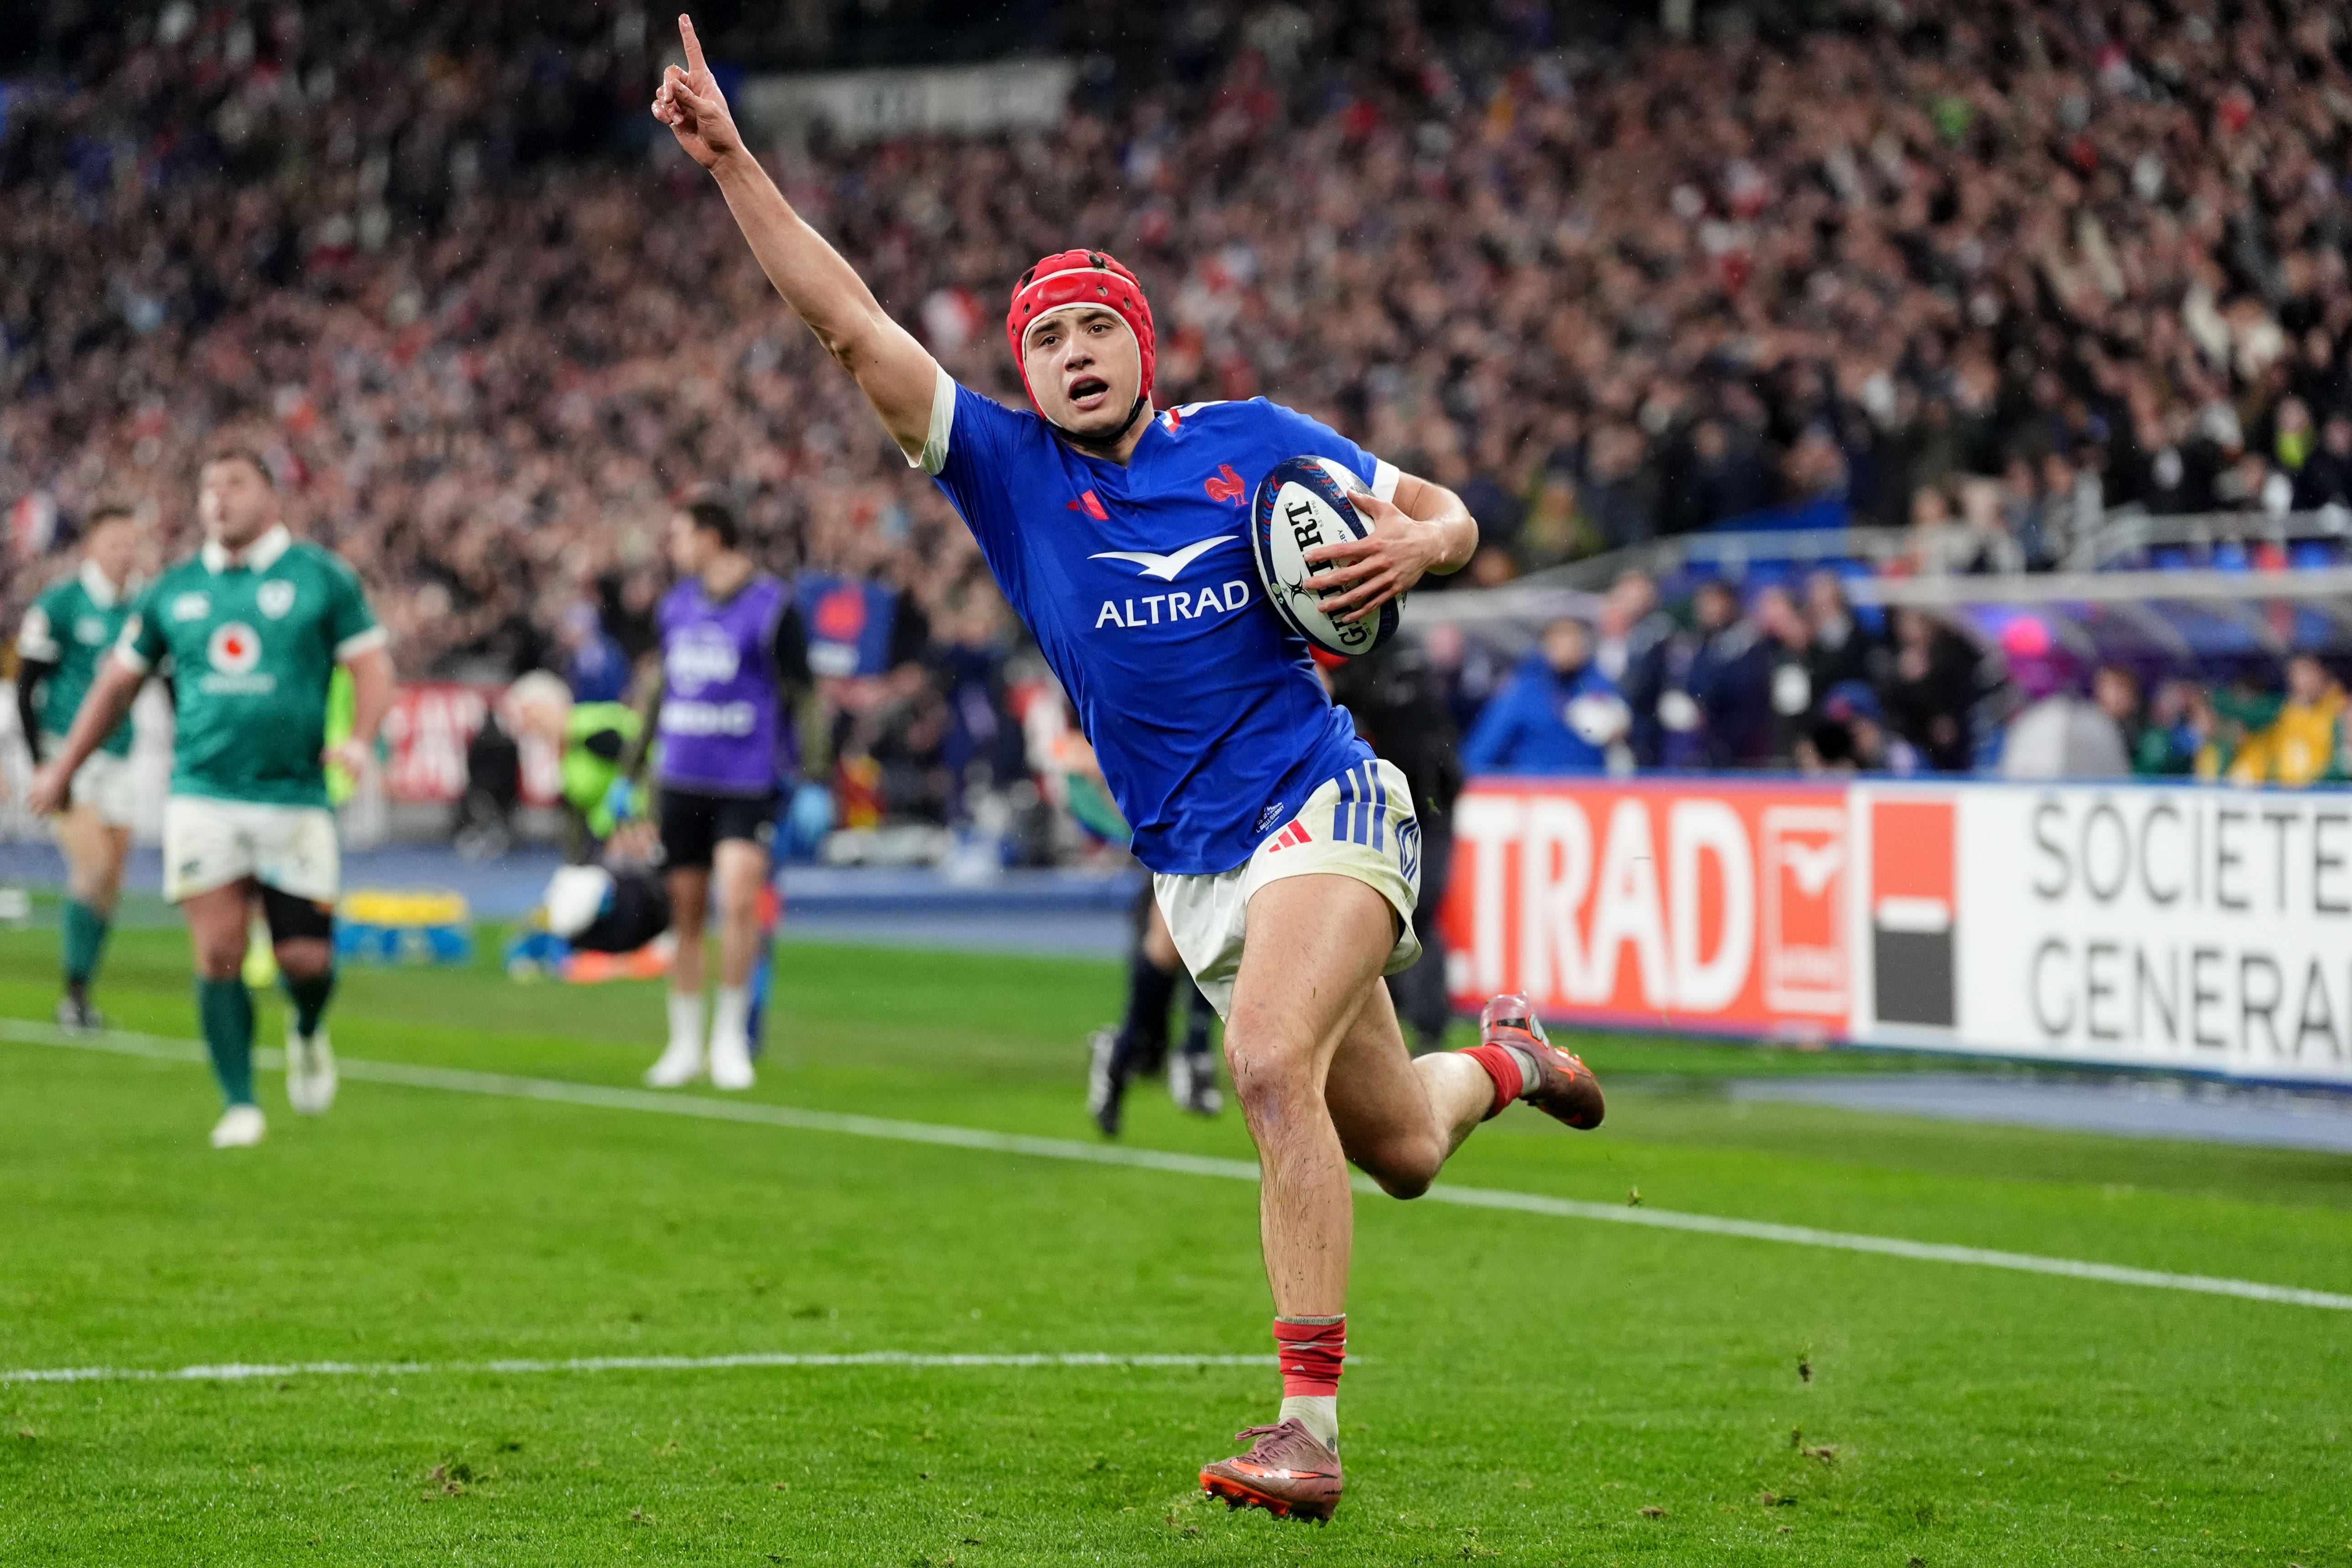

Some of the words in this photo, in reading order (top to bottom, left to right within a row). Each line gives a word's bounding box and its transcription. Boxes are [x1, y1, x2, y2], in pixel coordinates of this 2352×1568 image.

[1095, 580, 1250, 628] ALTRAD
[1446, 793, 1756, 1011] TRAD
[2032, 799, 2352, 913] SOCIETE
[2031, 934, 2352, 1060] GENERA
